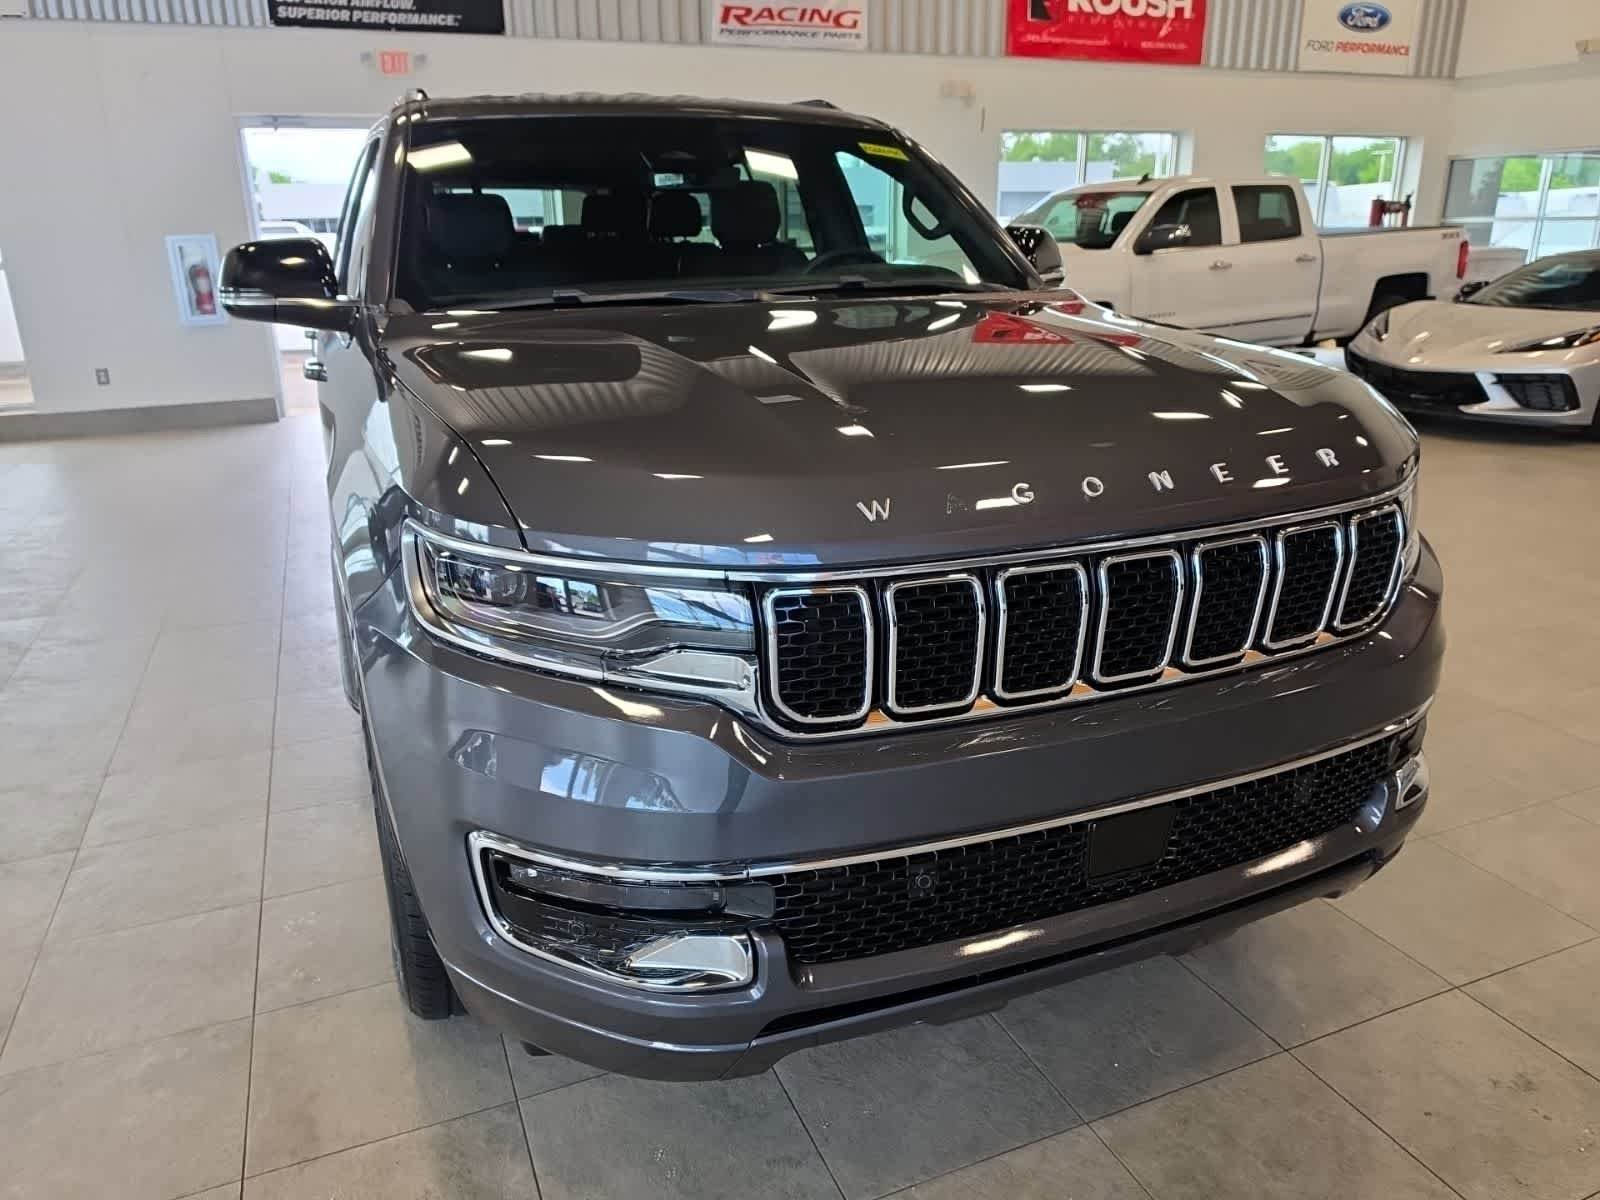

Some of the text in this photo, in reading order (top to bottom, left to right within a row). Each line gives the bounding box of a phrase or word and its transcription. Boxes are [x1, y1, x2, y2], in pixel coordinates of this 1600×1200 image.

[277, 6, 350, 22] SUPERIOR
[721, 5, 861, 29] RACING
[1347, 7, 1381, 28] Ford
[719, 28, 861, 40] PERFORMANCE PARTS
[1305, 40, 1409, 57] FORD PERFORMANCE
[380, 52, 409, 74] EXIT
